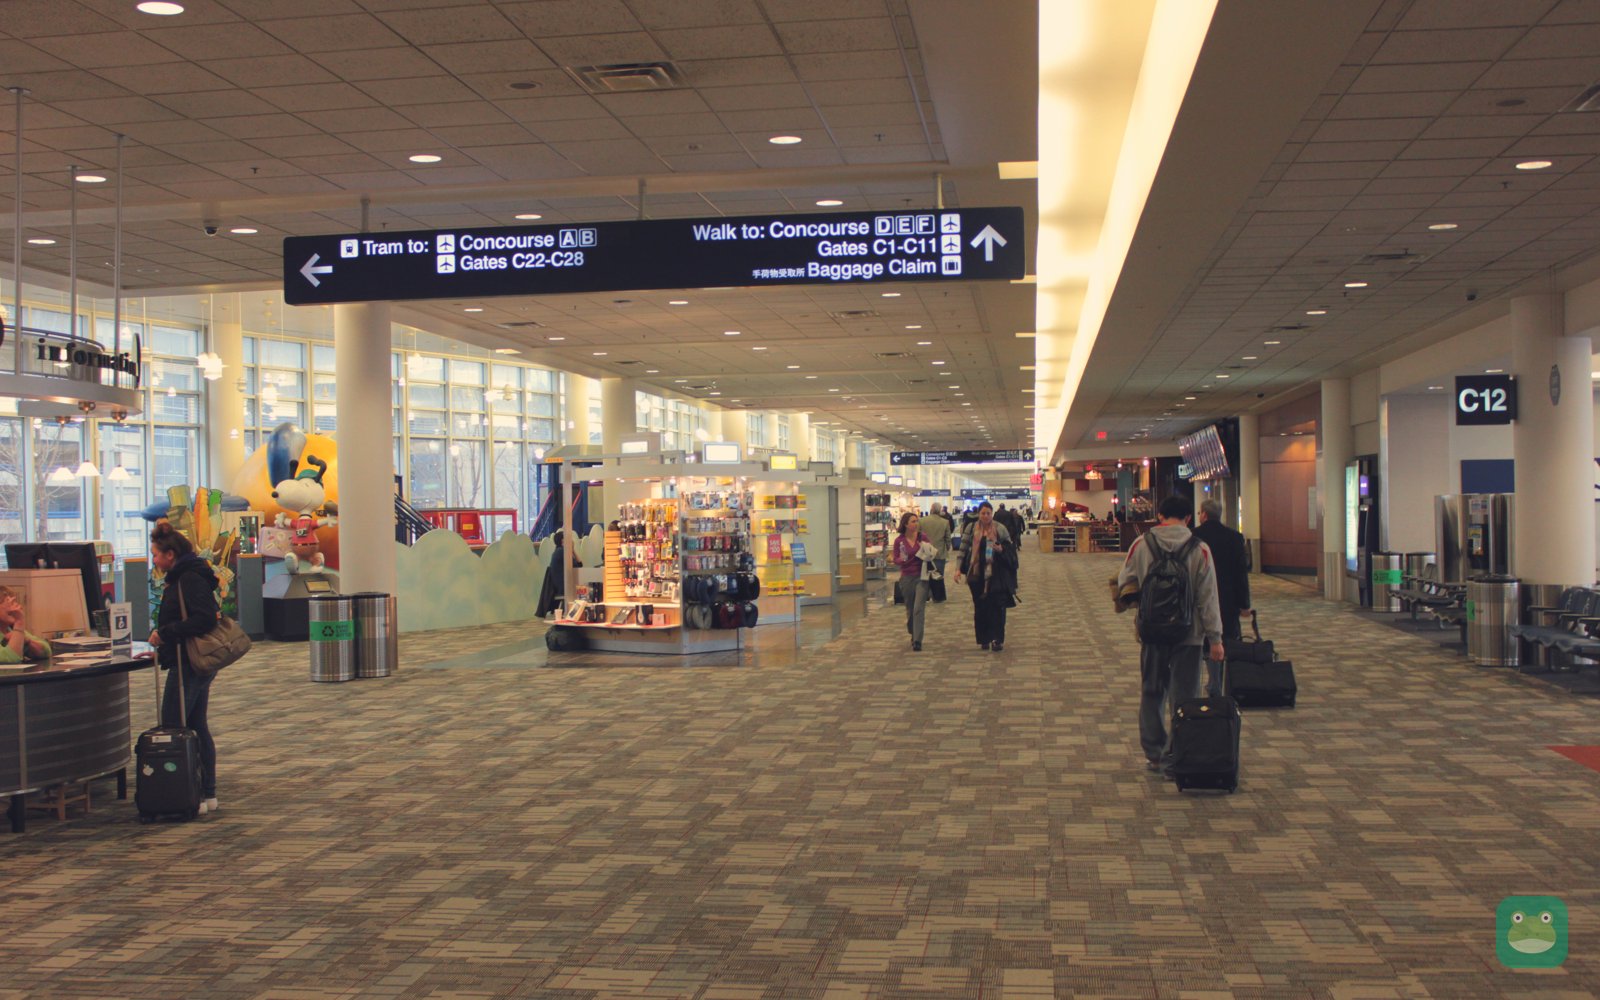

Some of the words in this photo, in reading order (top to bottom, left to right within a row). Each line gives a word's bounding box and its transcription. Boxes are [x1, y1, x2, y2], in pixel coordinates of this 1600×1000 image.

[693, 223, 737, 241] Walk
[741, 223, 765, 240] to:
[769, 219, 870, 239] Concourse
[363, 239, 403, 255] Tram
[407, 238, 429, 254] to:
[459, 235, 555, 250] Concourse
[817, 240, 868, 257] Gates
[872, 237, 937, 256] C1-C11
[459, 254, 508, 271] Gates
[512, 252, 584, 269] C22-C28
[807, 262, 884, 281] Baggage
[888, 258, 937, 275] Claim
[752, 267, 805, 279] 手荷物受取所
[1458, 388, 1508, 413] C12
